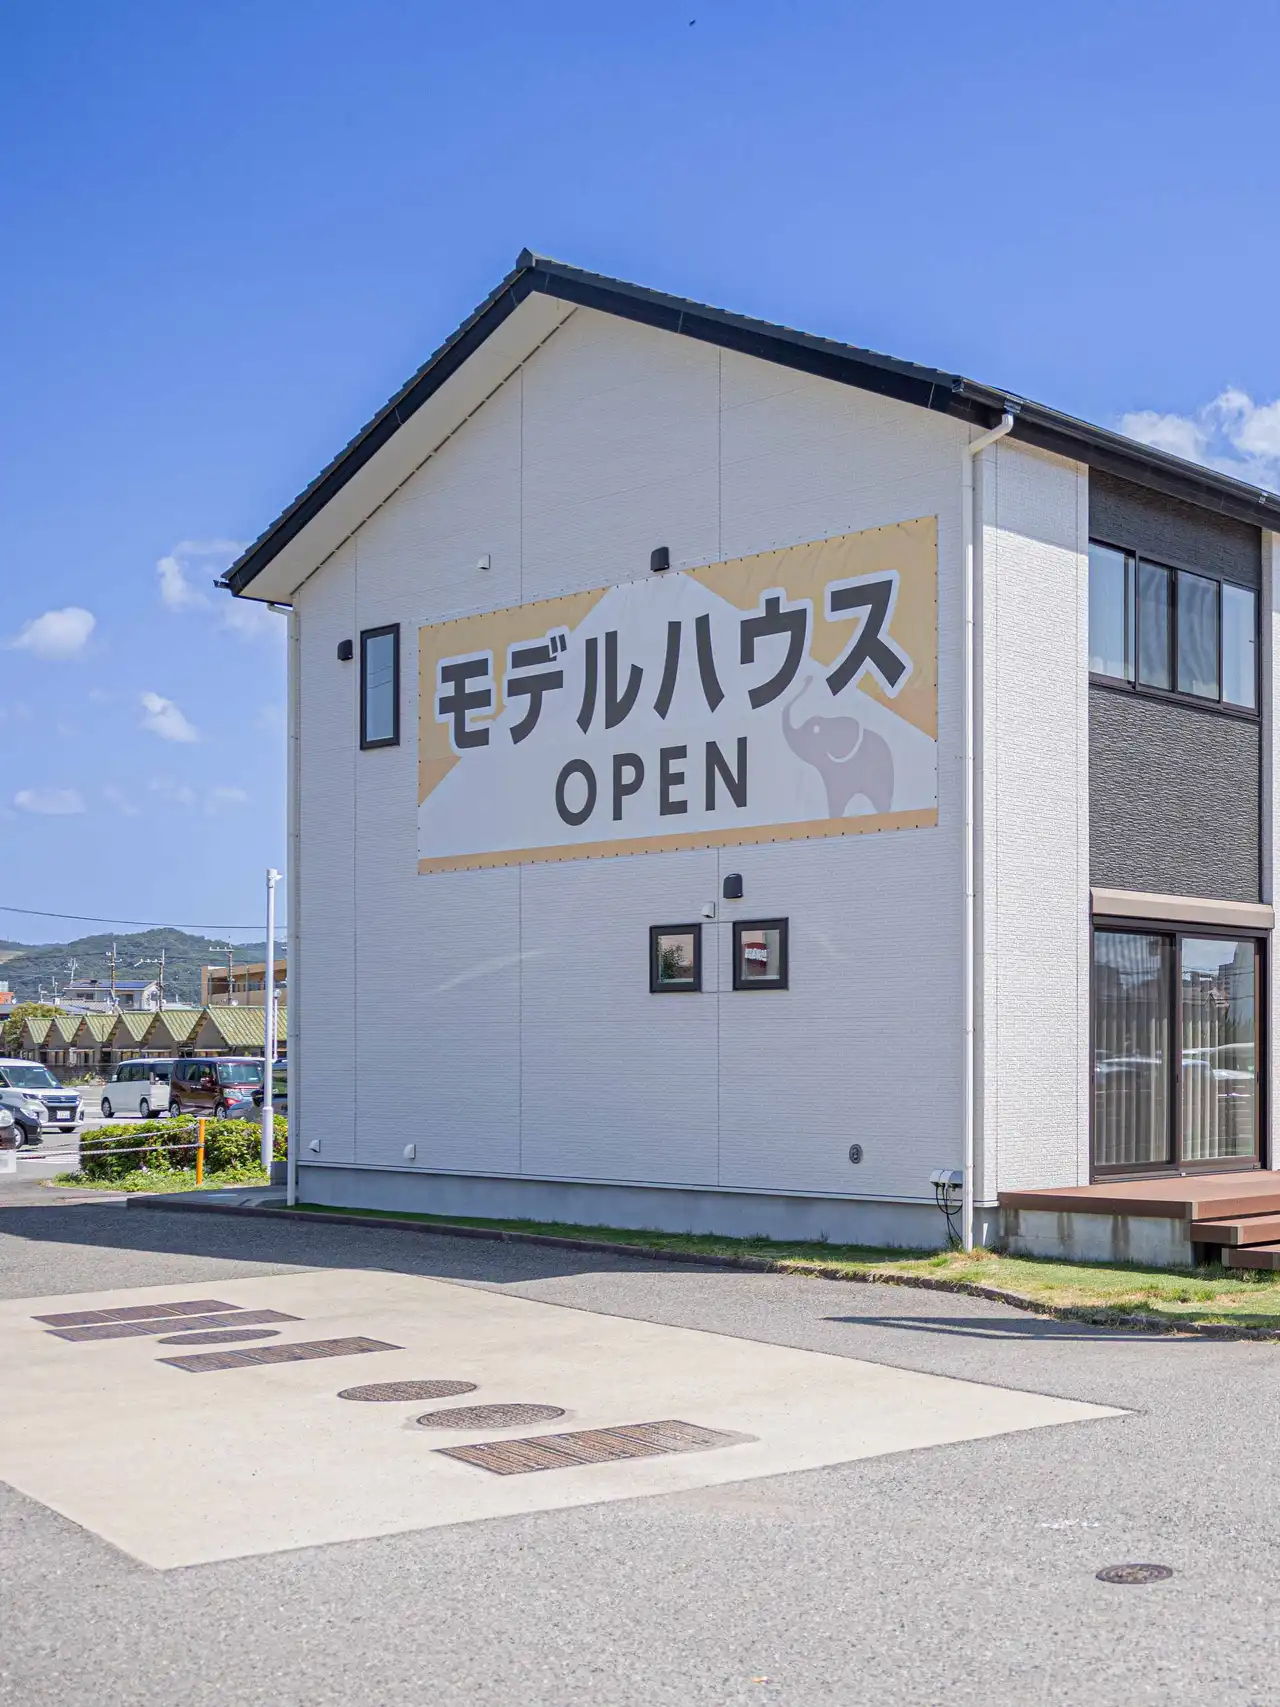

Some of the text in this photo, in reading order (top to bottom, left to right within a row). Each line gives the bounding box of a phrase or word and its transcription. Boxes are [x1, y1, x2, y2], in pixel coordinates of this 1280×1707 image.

[439, 579, 907, 749] モデルハウス
[555, 736, 748, 827] OPEN
